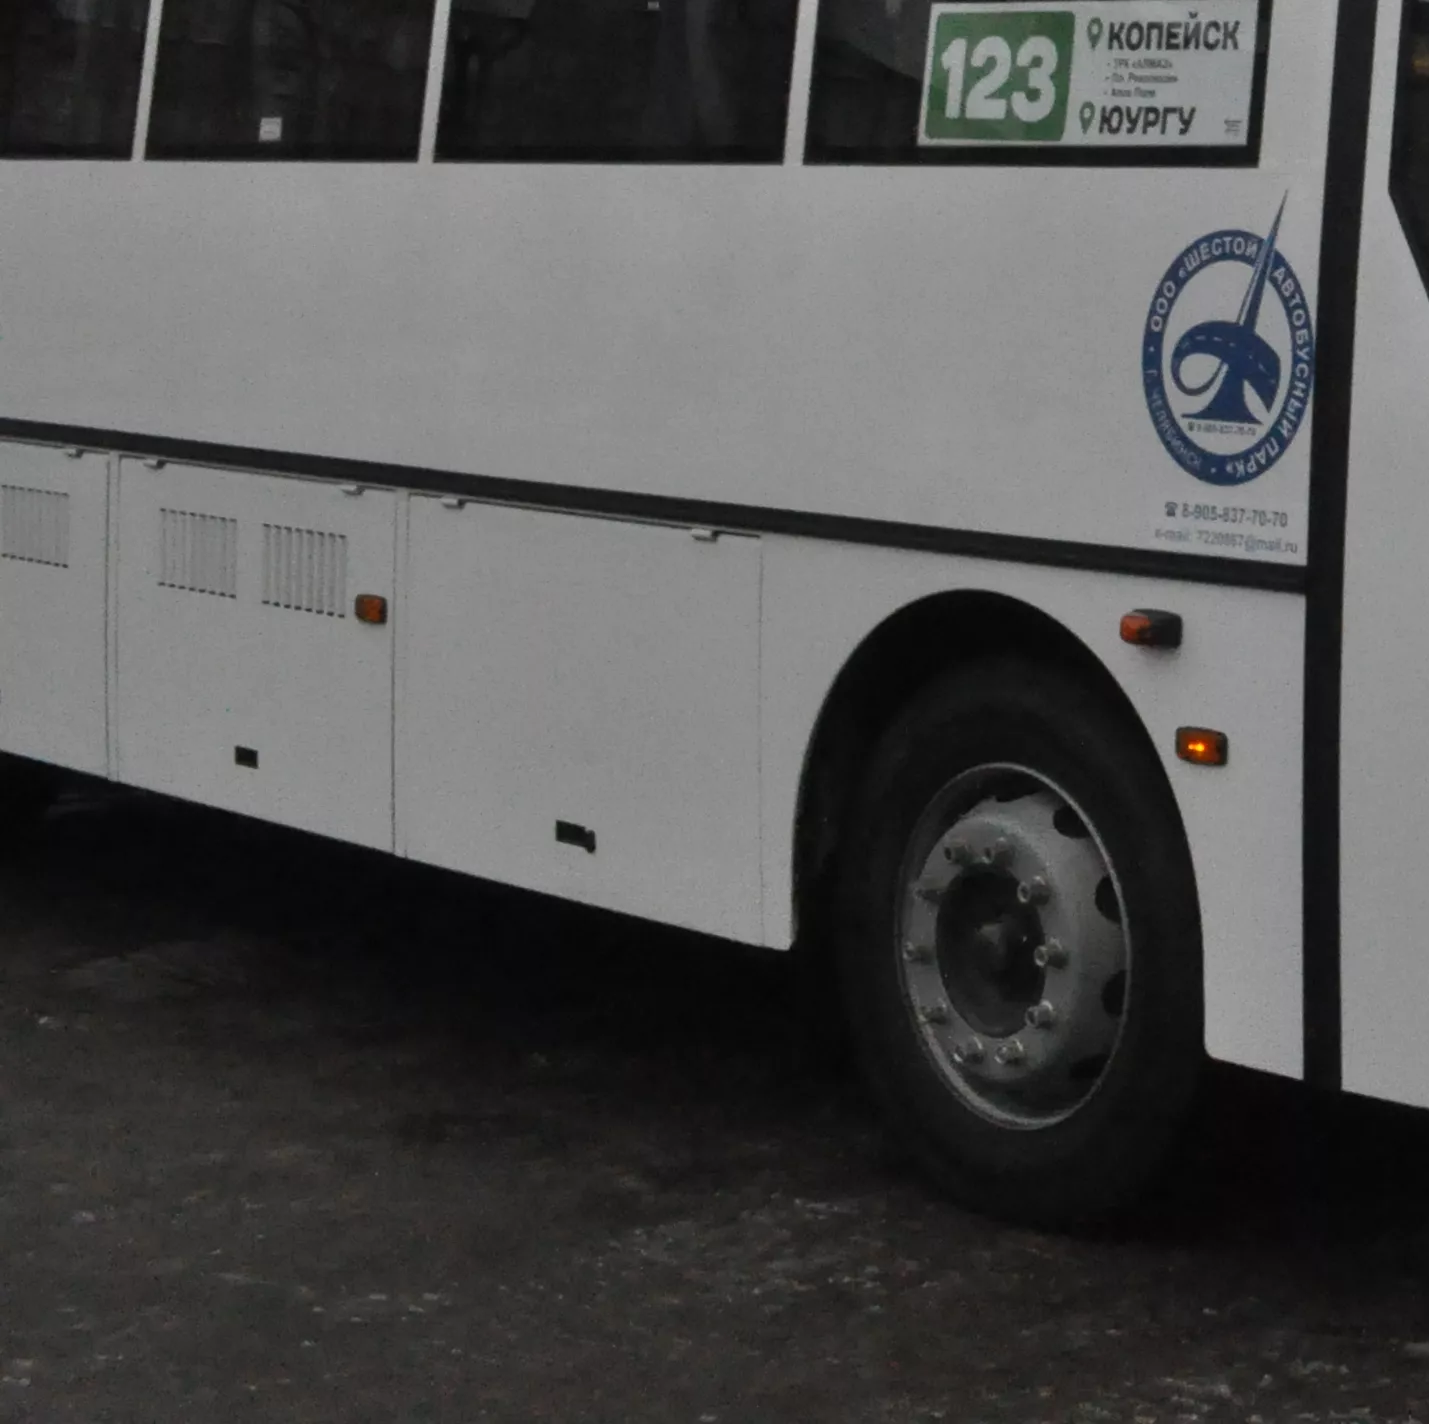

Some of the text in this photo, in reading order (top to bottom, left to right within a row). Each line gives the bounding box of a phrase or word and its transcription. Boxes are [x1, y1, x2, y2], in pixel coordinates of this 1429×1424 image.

[1107, 10, 1241, 51] КОПЕЙСК
[940, 35, 1059, 123] 123
[1099, 105, 1197, 136] ЮУРГУ
[1272, 265, 1311, 439] АВТОБУСНЫЙ
